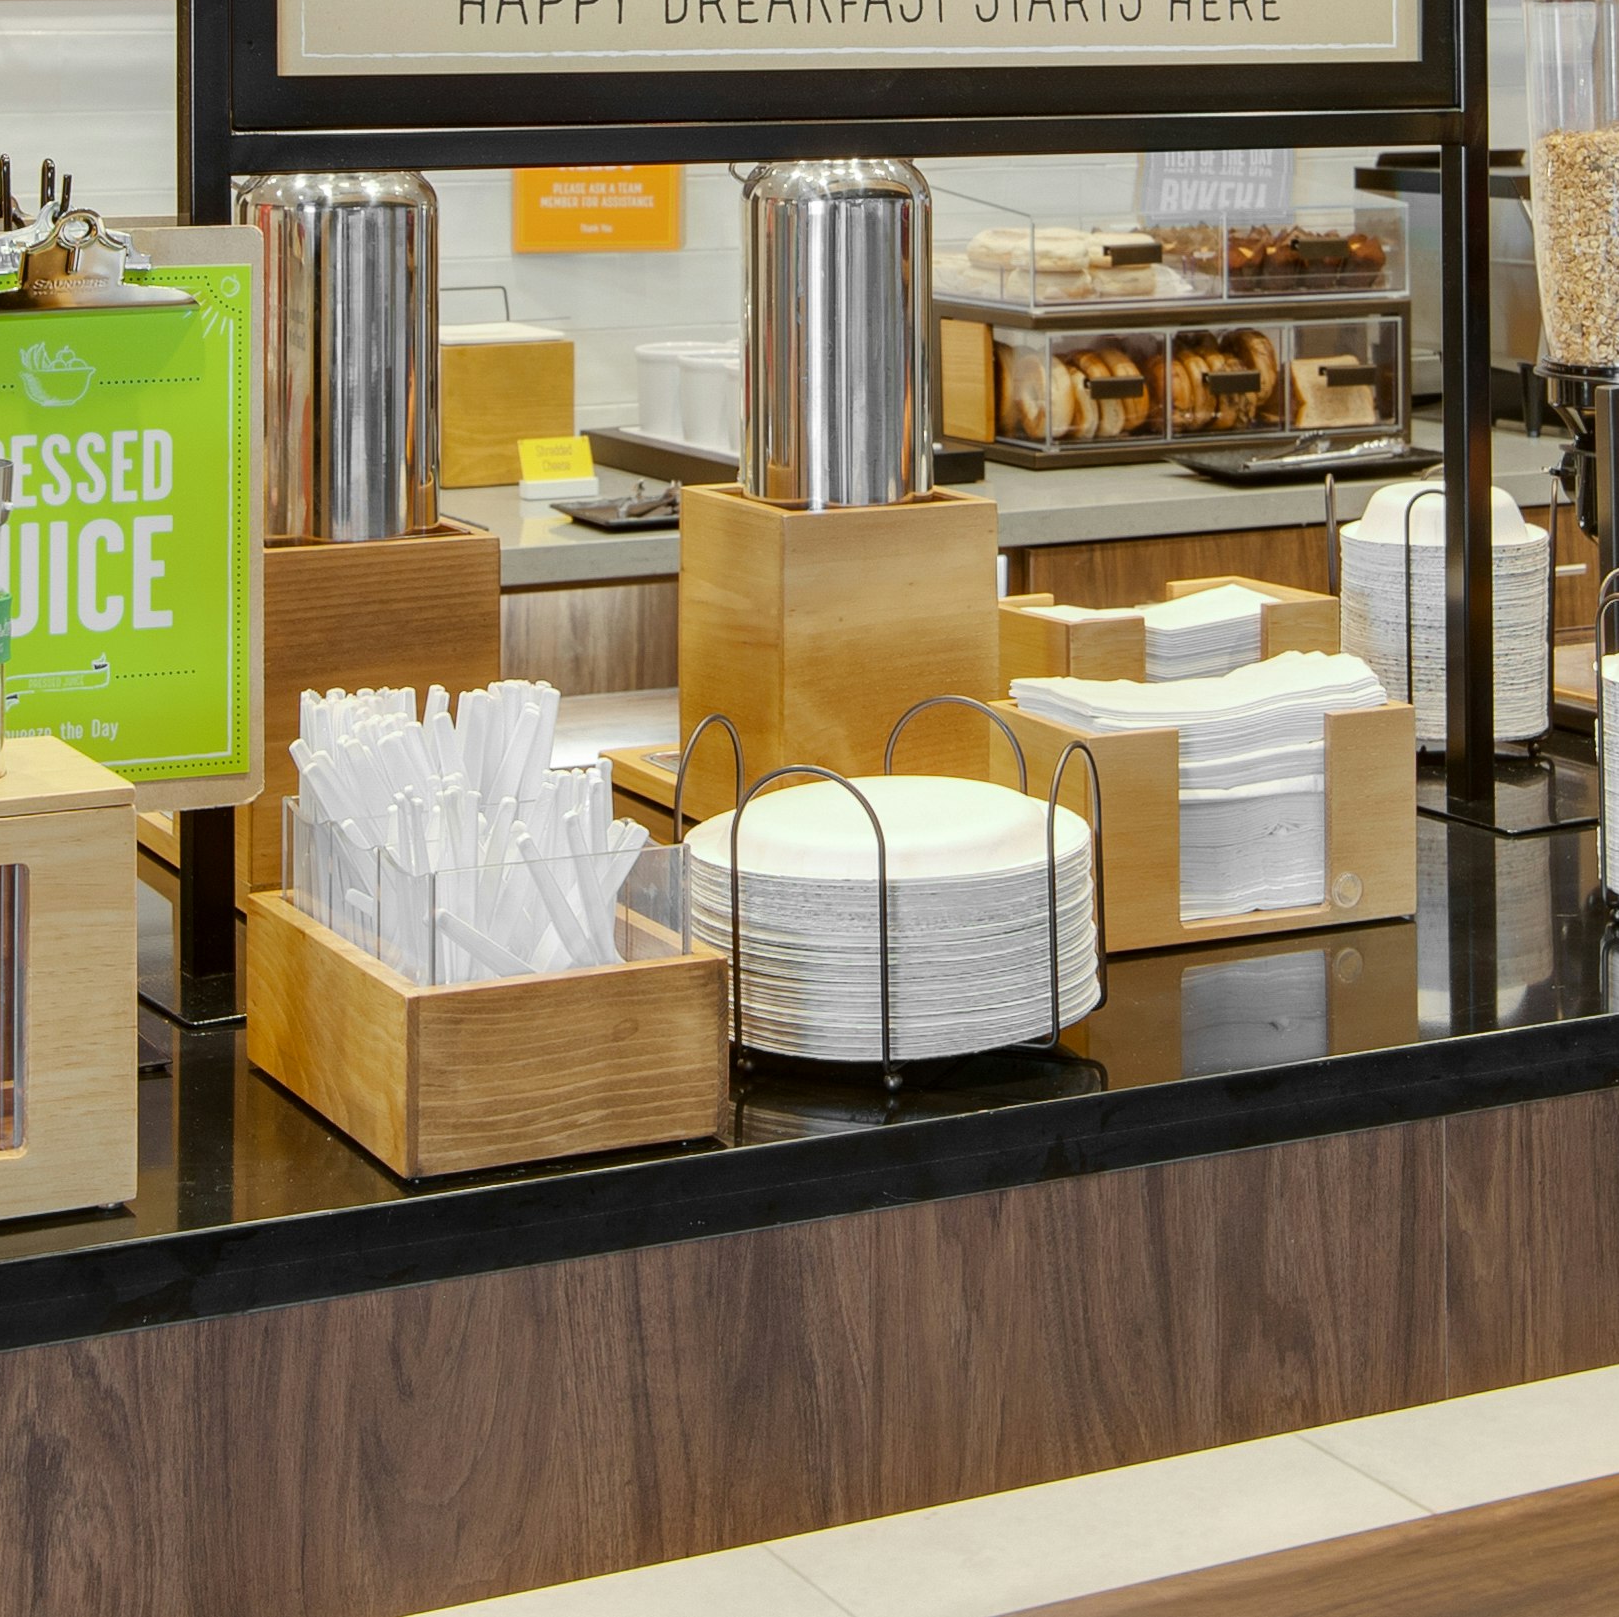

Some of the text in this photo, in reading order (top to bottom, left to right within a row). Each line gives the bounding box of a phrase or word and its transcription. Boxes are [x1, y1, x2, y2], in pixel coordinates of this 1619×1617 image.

[552, 182, 642, 194] PLEASE ASK A TEAM
[540, 196, 654, 208] MEMBER FOR ASSISTANCE
[0, 515, 173, 638] UICE
[60, 722, 84, 740] the
[91, 719, 119, 741] Day
